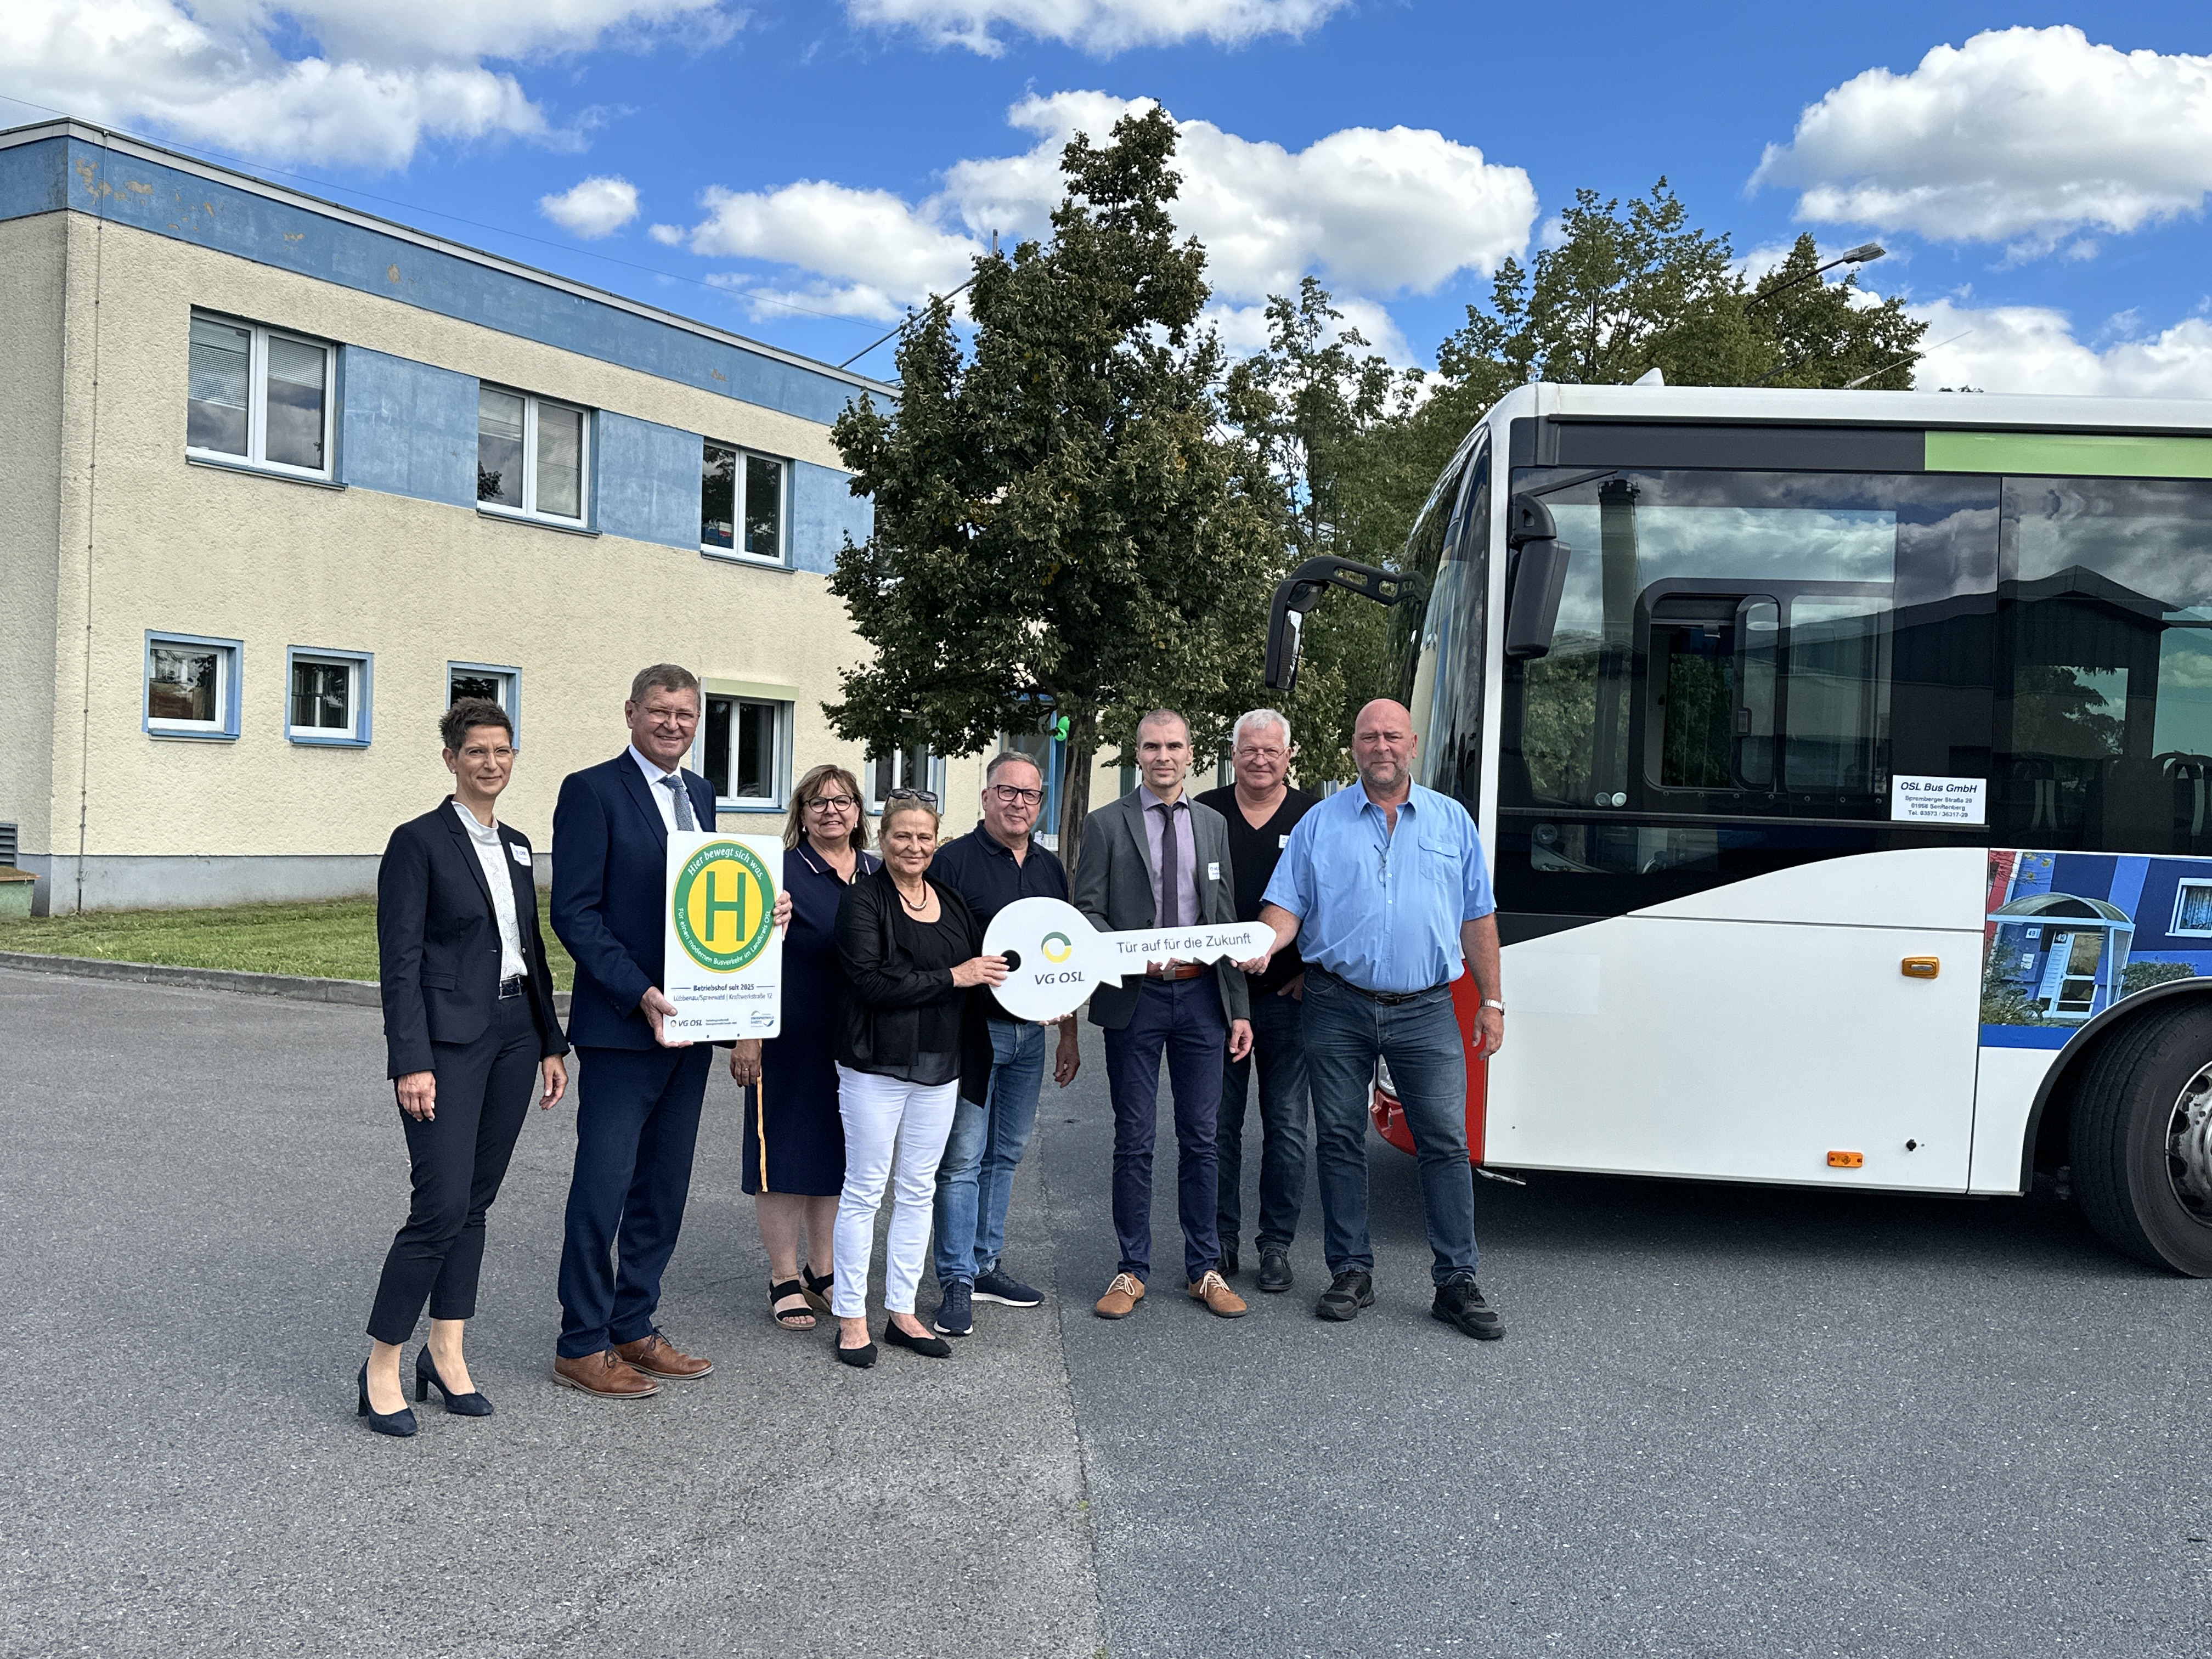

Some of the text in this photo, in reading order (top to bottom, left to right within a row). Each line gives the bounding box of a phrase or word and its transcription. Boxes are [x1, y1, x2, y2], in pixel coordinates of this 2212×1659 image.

[1901, 782, 1977, 793] OSL Bus GmbH
[687, 848, 764, 880] Hier bewegt sich was.
[705, 871, 746, 941] H
[680, 921, 690, 940] einen
[688, 940, 713, 963] modernen
[713, 956, 743, 966] Busverkehr
[744, 951, 751, 959] im
[750, 924, 768, 953] Landkreis
[1116, 933, 1251, 953] Tür auf für die Zukunft
[1035, 971, 1085, 985] VG OSL
